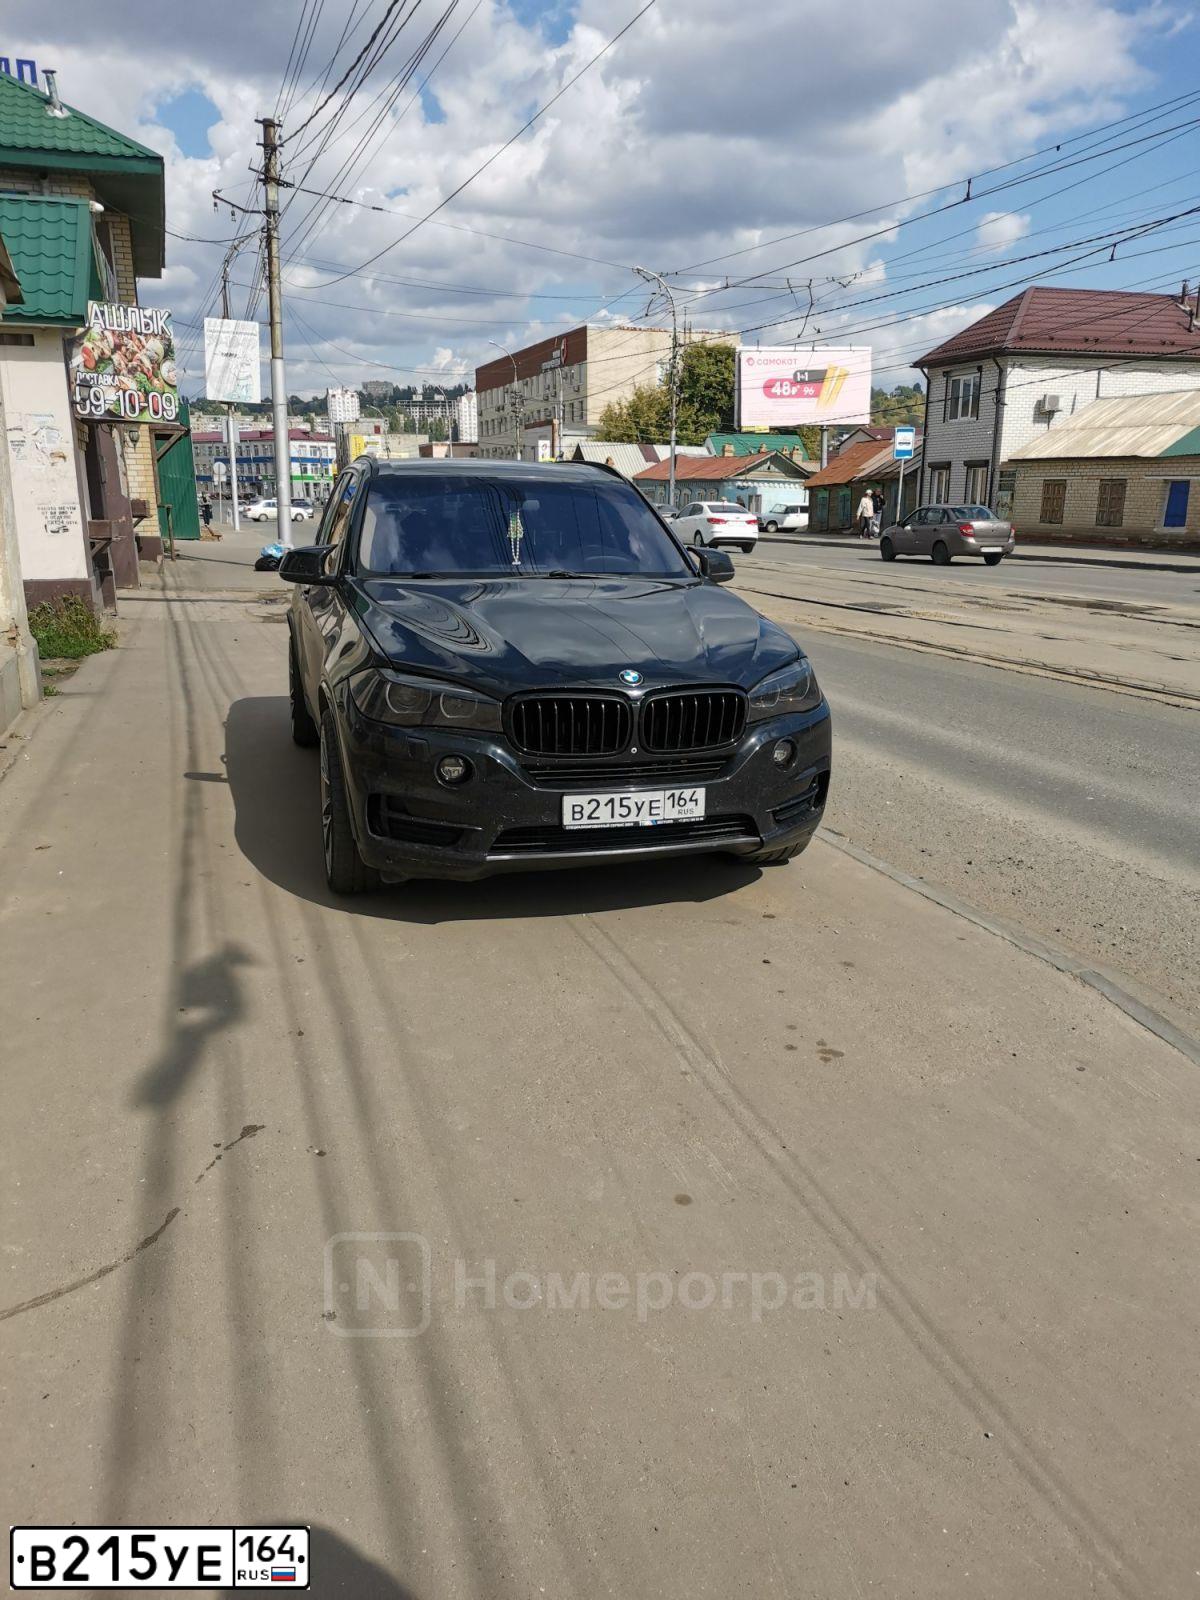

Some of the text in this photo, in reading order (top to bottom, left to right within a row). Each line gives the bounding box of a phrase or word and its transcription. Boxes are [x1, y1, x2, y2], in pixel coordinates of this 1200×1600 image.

[85, 302, 174, 337] АШЛЫК
[796, 371, 809, 382] 1+1
[572, 790, 699, 821] В215УЕ 164
